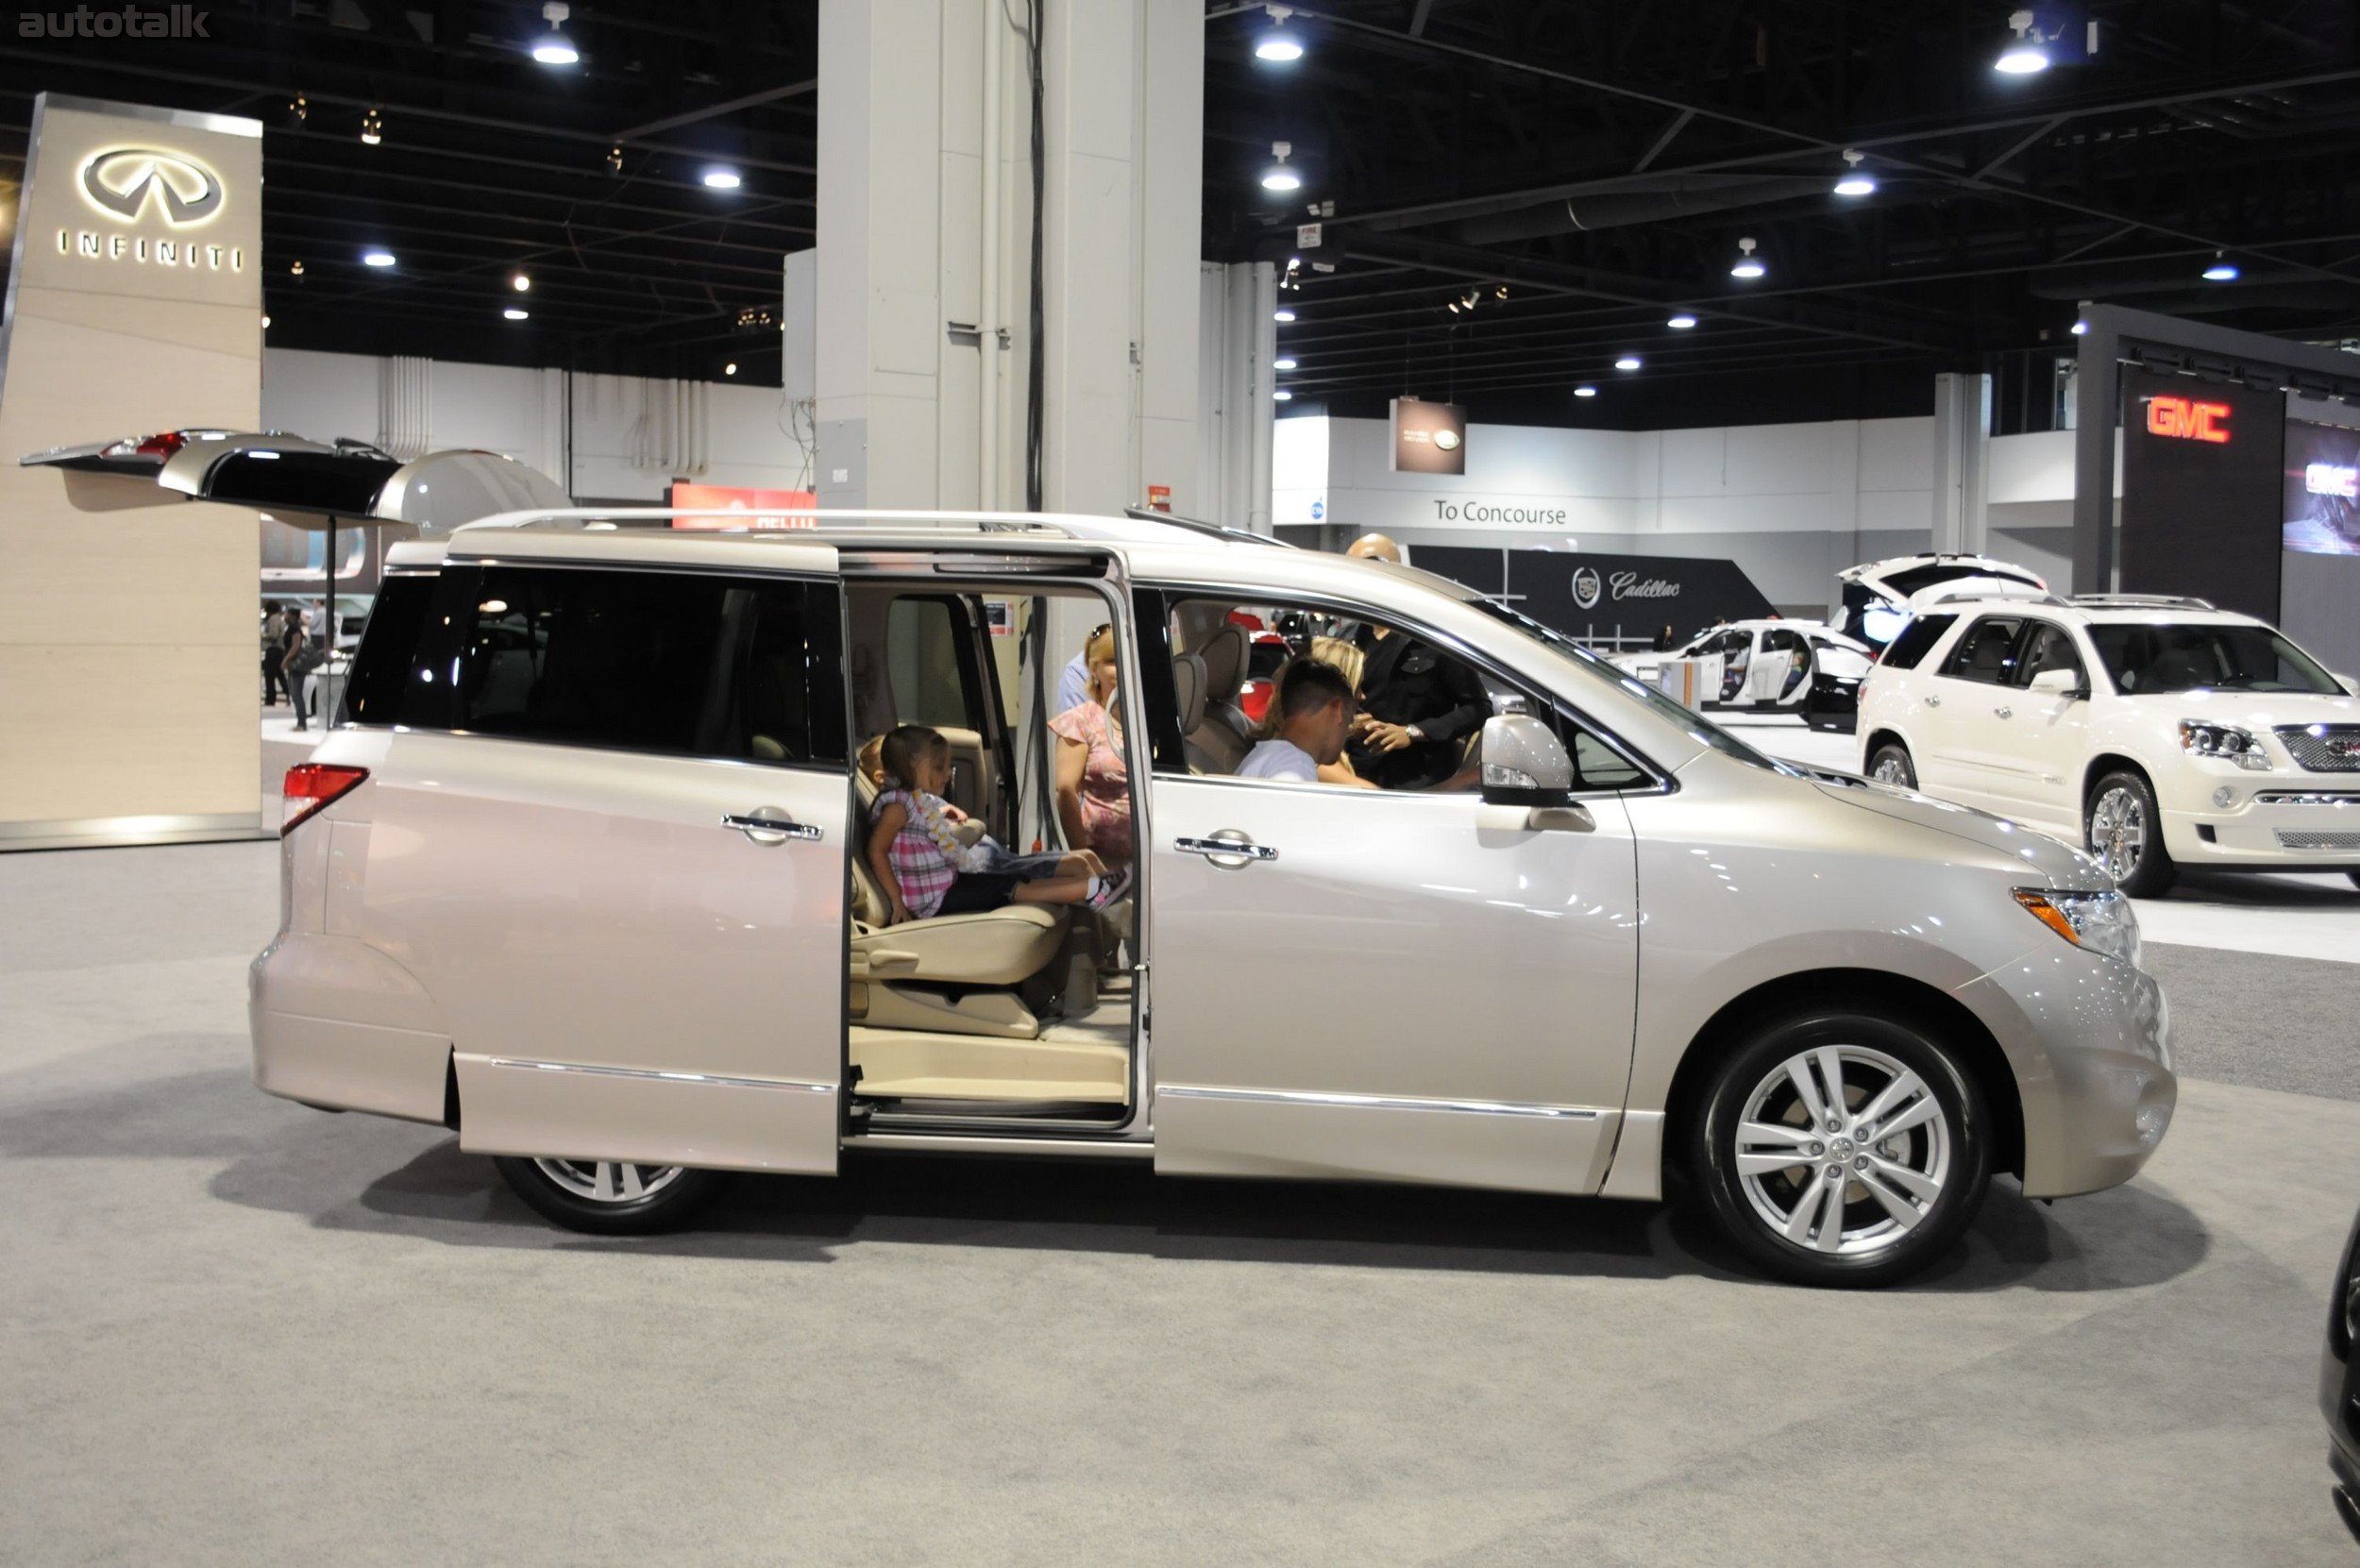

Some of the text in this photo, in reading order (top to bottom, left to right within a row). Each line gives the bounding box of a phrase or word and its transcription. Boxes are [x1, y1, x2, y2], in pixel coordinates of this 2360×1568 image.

[59, 230, 242, 271] INFINITI
[2148, 396, 2232, 444] GMC
[2306, 464, 2357, 497] GMC
[1434, 500, 1567, 525] To Concourse
[1609, 571, 1680, 600] Cadillac
